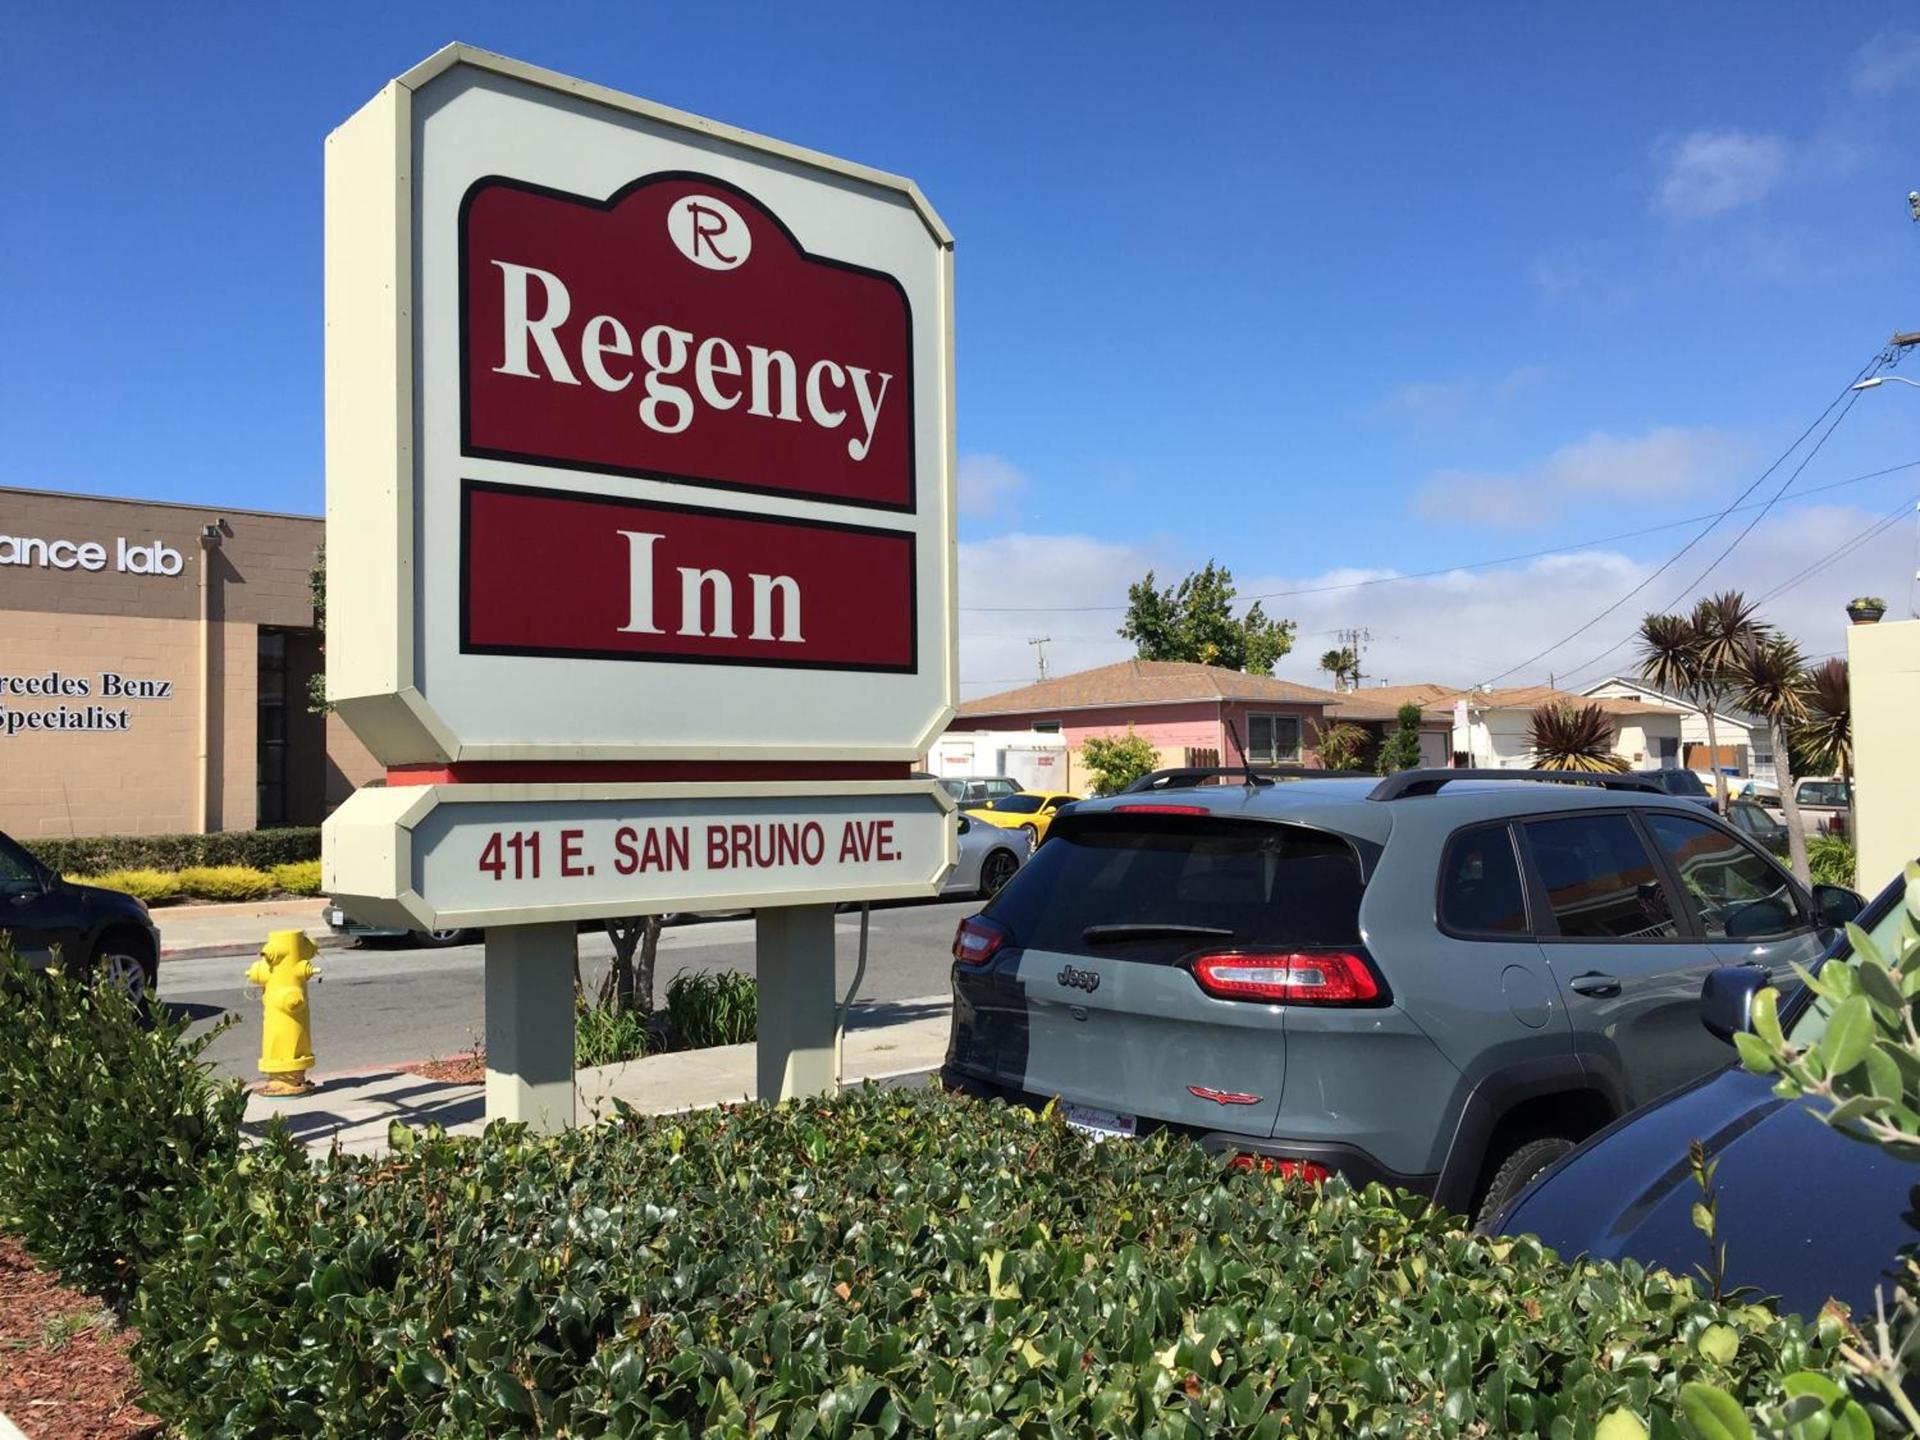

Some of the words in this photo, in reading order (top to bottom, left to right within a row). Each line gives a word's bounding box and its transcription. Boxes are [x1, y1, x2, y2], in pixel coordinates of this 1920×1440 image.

[686, 201, 738, 264] R
[490, 259, 894, 462] Regency
[0, 535, 107, 571] ance
[117, 537, 184, 576] lab
[616, 530, 806, 643] Inn
[101, 673, 172, 698] Benz
[478, 830, 541, 881] 411
[560, 829, 595, 877] E.
[614, 826, 690, 875] SAN
[706, 820, 826, 870] BRUNO
[838, 820, 903, 863] AVE.
[1057, 964, 1100, 993] Jeep
